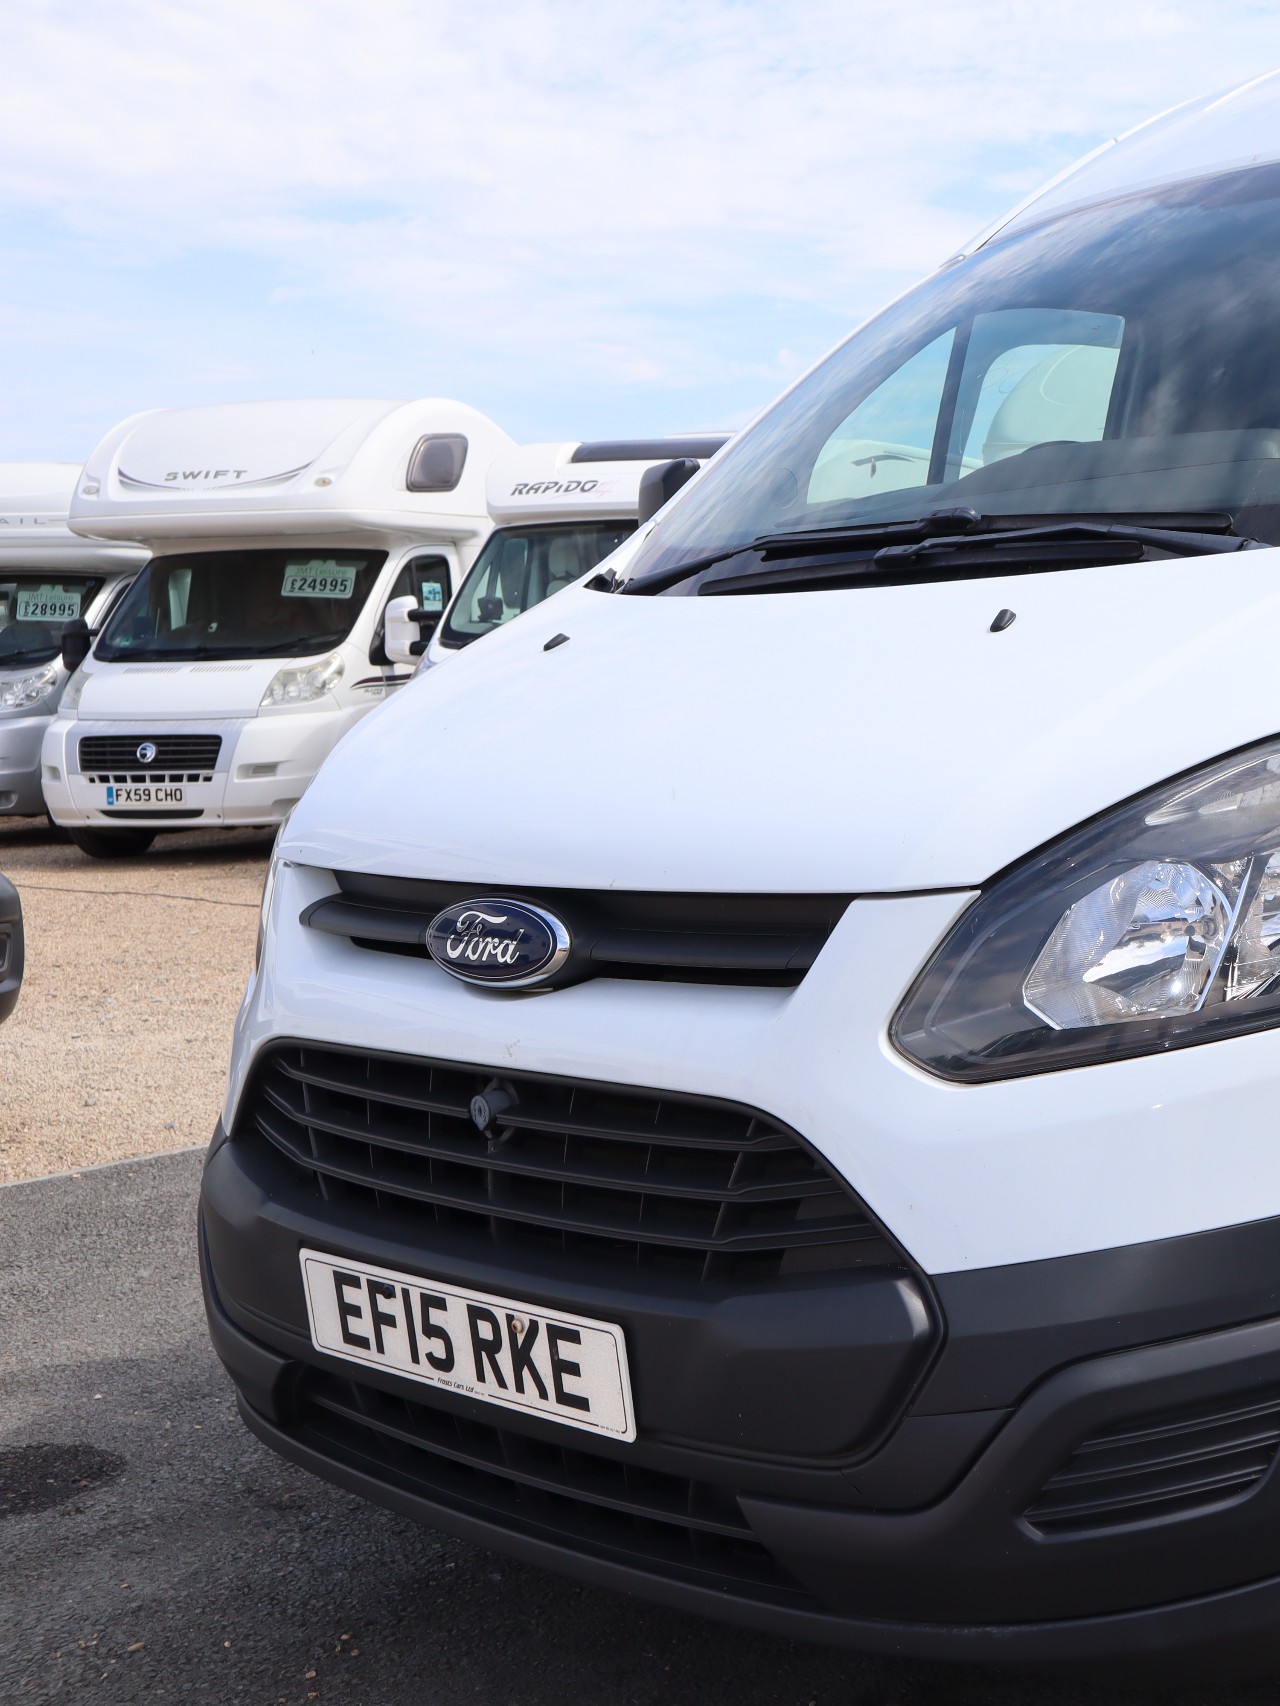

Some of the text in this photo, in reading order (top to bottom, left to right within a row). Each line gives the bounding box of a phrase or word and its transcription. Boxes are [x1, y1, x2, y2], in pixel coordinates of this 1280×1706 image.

[164, 470, 248, 481] SWIFT
[289, 578, 348, 593] £24995
[115, 788, 183, 802] FX59 CHO
[446, 911, 525, 964] Ford
[332, 1270, 591, 1412] EF15 RKE
[453, 1381, 465, 1391] Cars
